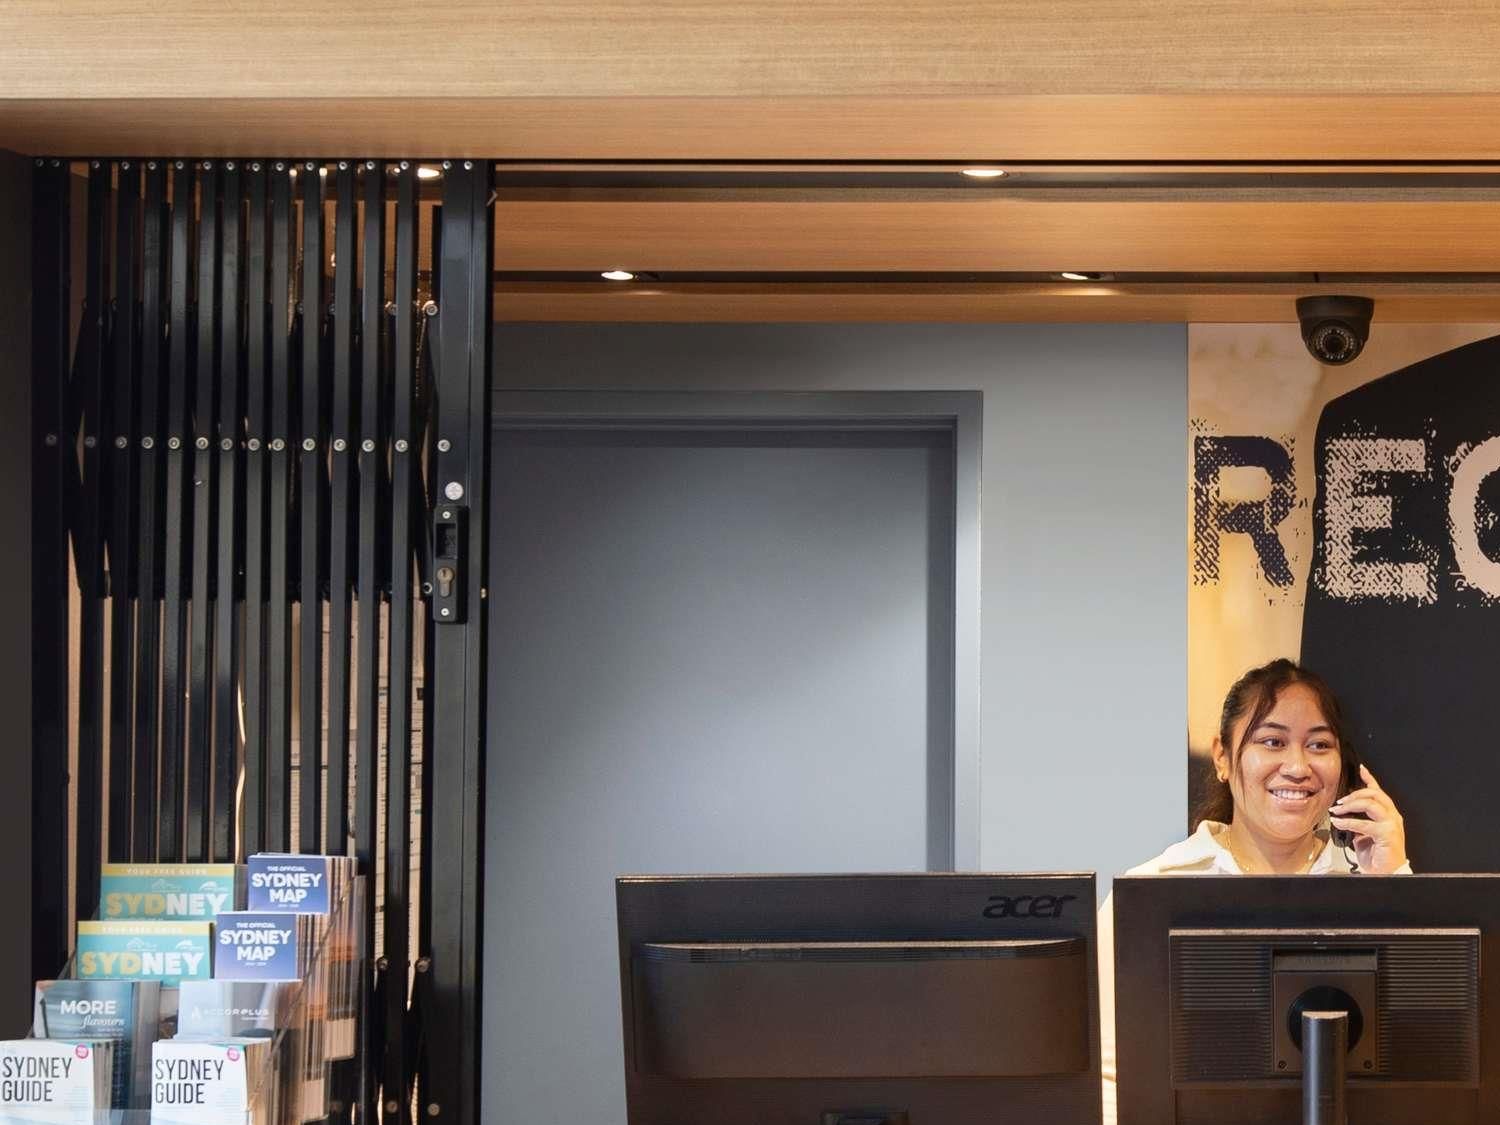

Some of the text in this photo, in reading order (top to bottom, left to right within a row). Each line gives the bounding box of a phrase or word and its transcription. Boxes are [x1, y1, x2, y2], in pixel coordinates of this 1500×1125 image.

[252, 873, 322, 888] SYDNEY
[106, 892, 228, 917] SYDNEY
[269, 889, 308, 903] MAP
[982, 894, 1079, 919] acer
[220, 930, 292, 945] SYDNEY
[81, 951, 204, 976] SYDNEY
[237, 946, 276, 961] MAP
[60, 1000, 117, 1015] MORE
[2, 1057, 73, 1079] SYDNEY
[155, 1059, 225, 1081] SYDNEY
[2, 1080, 54, 1102] GUIDE
[155, 1083, 206, 1104] GUIDE
